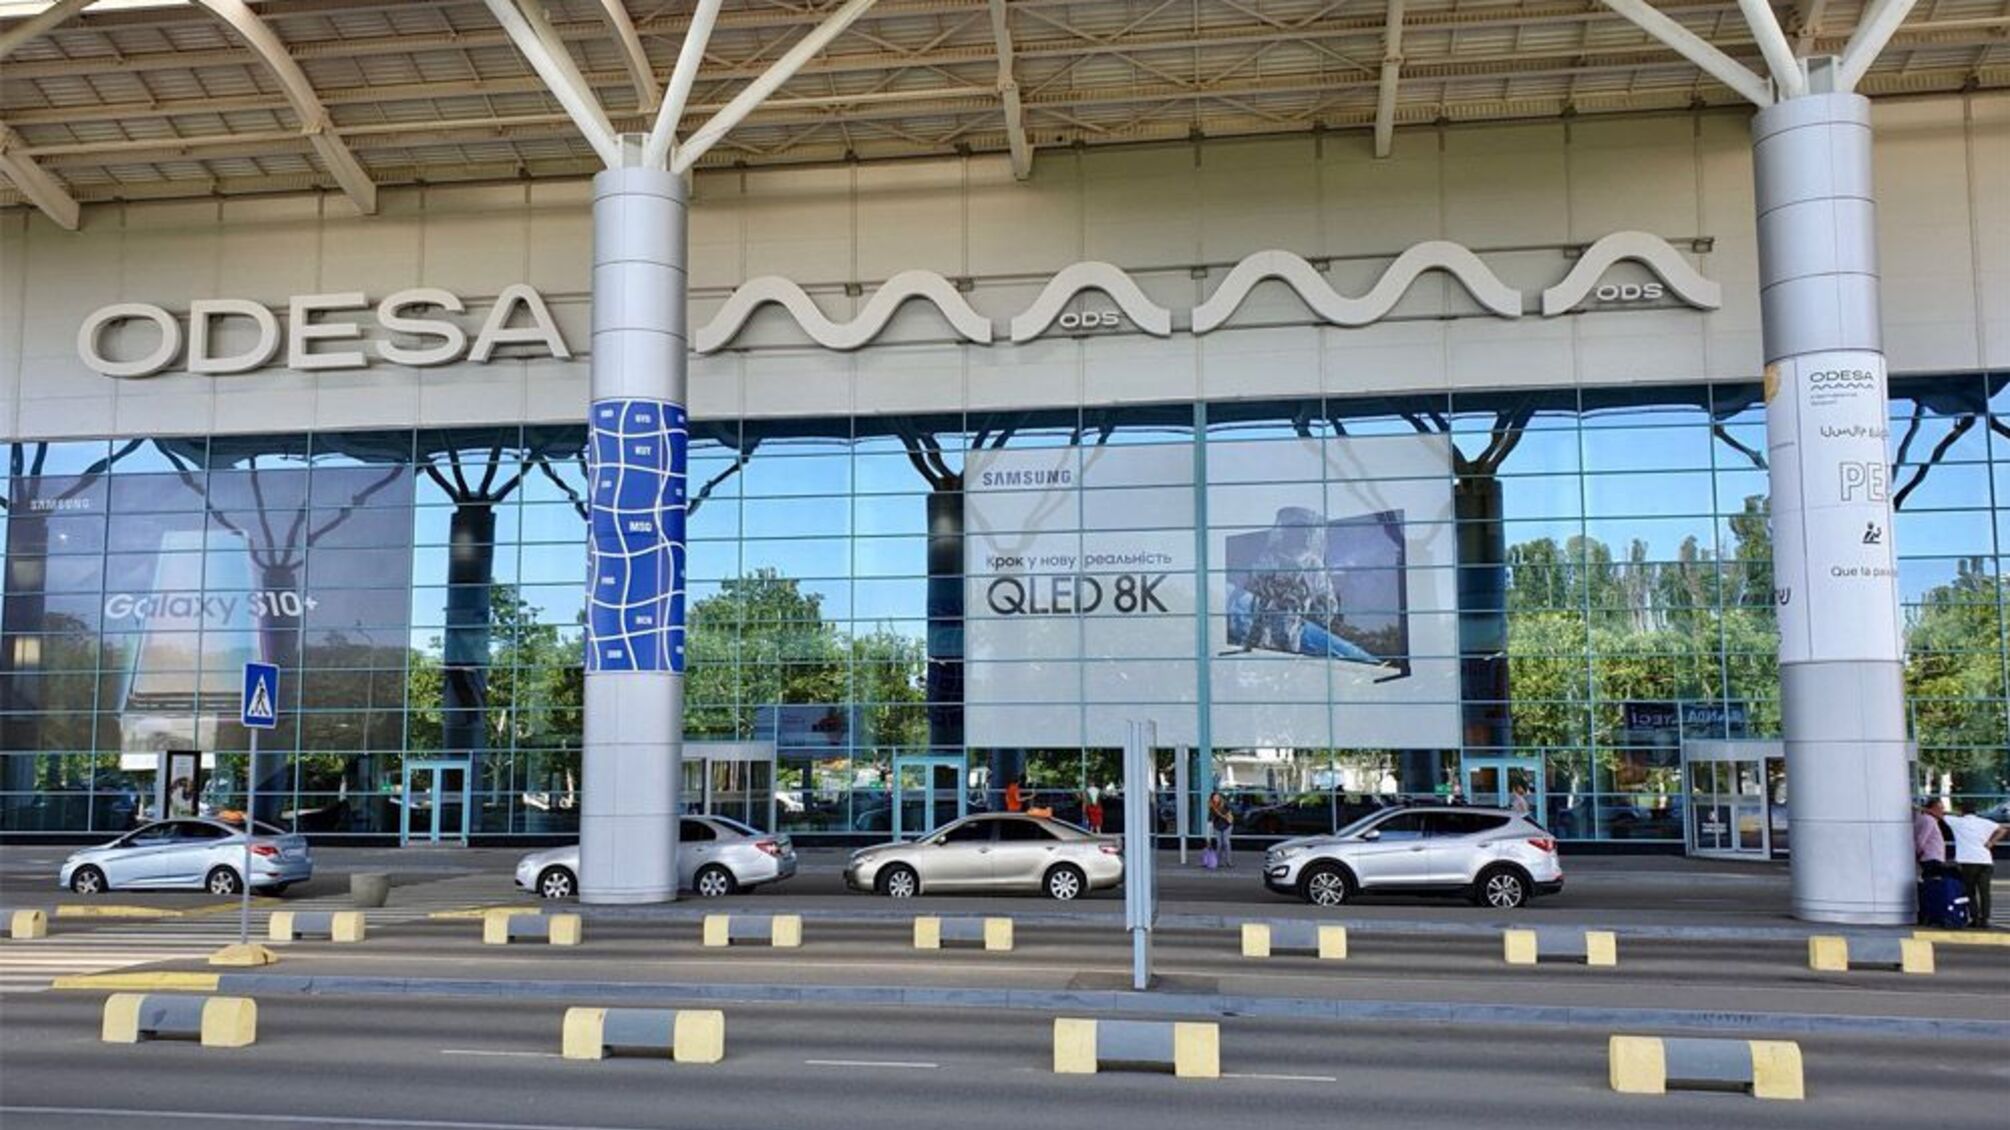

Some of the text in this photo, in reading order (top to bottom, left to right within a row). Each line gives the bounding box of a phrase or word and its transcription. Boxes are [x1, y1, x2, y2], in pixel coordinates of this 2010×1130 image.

[1596, 282, 1664, 301] ODS
[1059, 311, 1120, 328] ODS
[76, 283, 573, 378] ODESA
[1810, 370, 1874, 383] ODESA
[982, 470, 1072, 486] SAMSUNG
[1839, 461, 1889, 502] PE
[29, 498, 90, 511] SAMSUNG
[1027, 557, 1037, 570] у
[1040, 556, 1077, 570] нову
[1084, 551, 1173, 570] реальність
[1831, 566, 1858, 578] Que
[987, 574, 1169, 615] QLED 8K
[105, 590, 318, 625] Galaxy S10+
